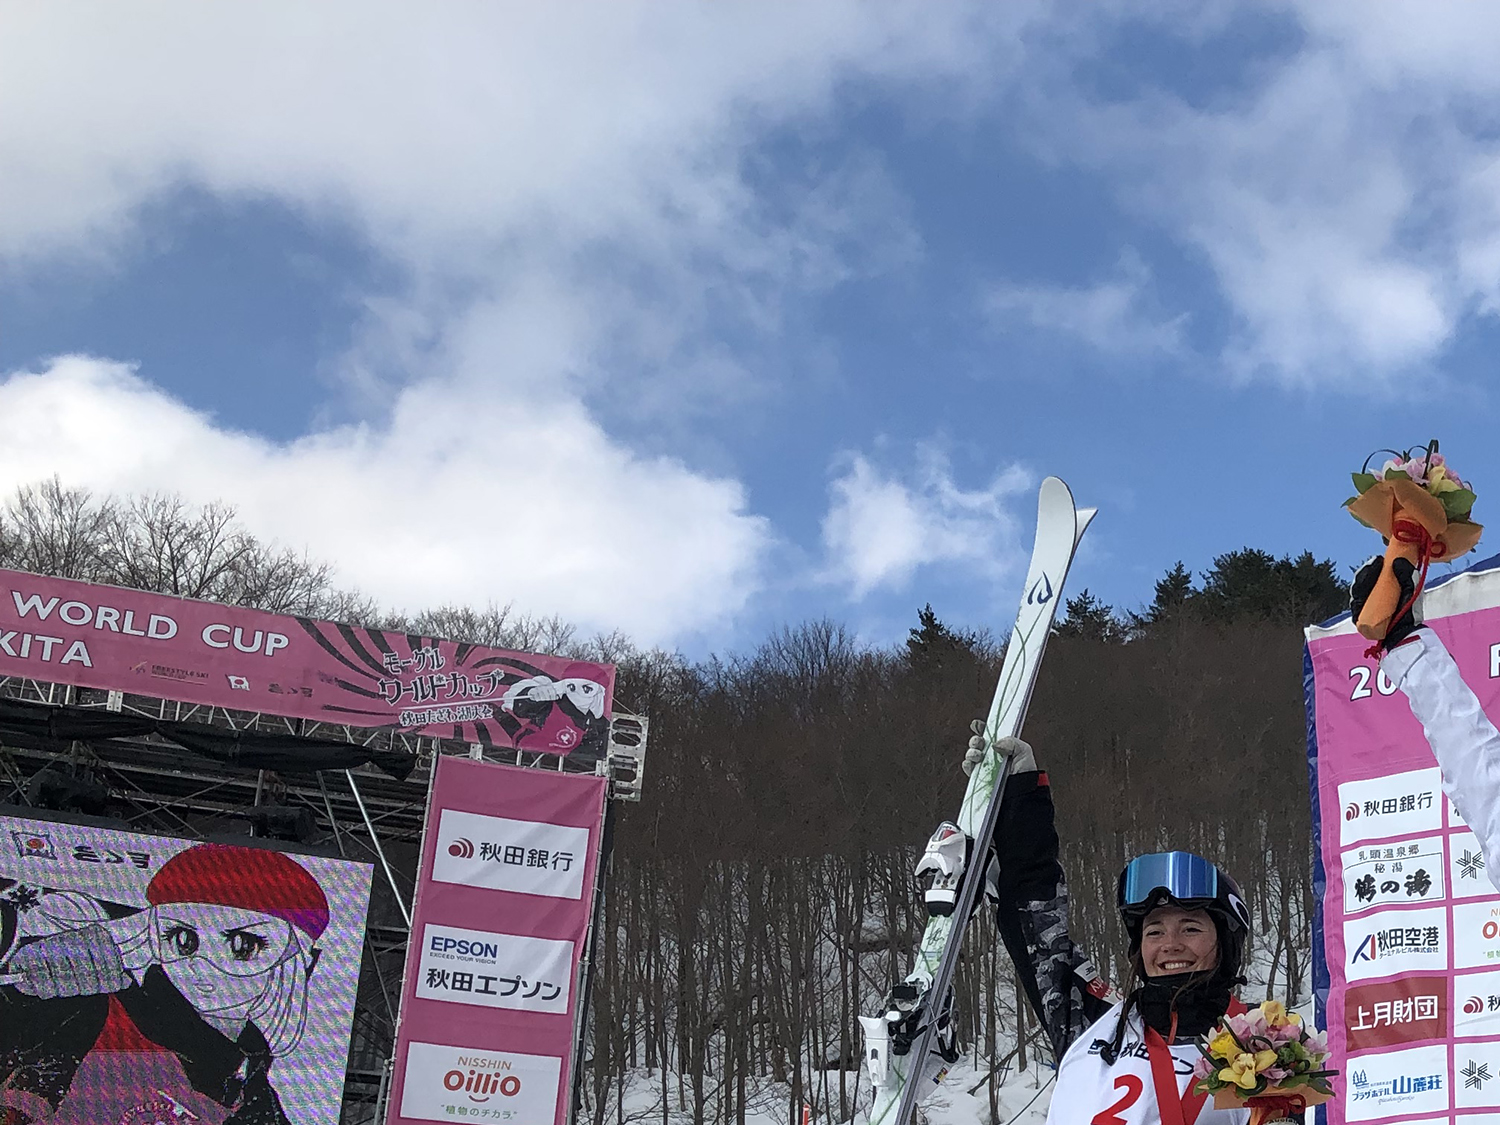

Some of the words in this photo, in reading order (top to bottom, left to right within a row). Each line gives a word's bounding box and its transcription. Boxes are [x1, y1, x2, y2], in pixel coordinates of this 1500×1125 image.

[10, 589, 179, 641] WORLD
[201, 622, 290, 657] CUP
[1363, 791, 1433, 817] 秋田銀行
[479, 841, 574, 872] 秋田銀行
[1358, 844, 1420, 861] 乳頭温泉郷
[431, 936, 498, 958] EPSON
[1377, 926, 1439, 950] 秋田空港
[425, 968, 562, 1001] 秋田エプソン
[1351, 995, 1439, 1031] 上月財団
[457, 1055, 512, 1070] NISSHIN
